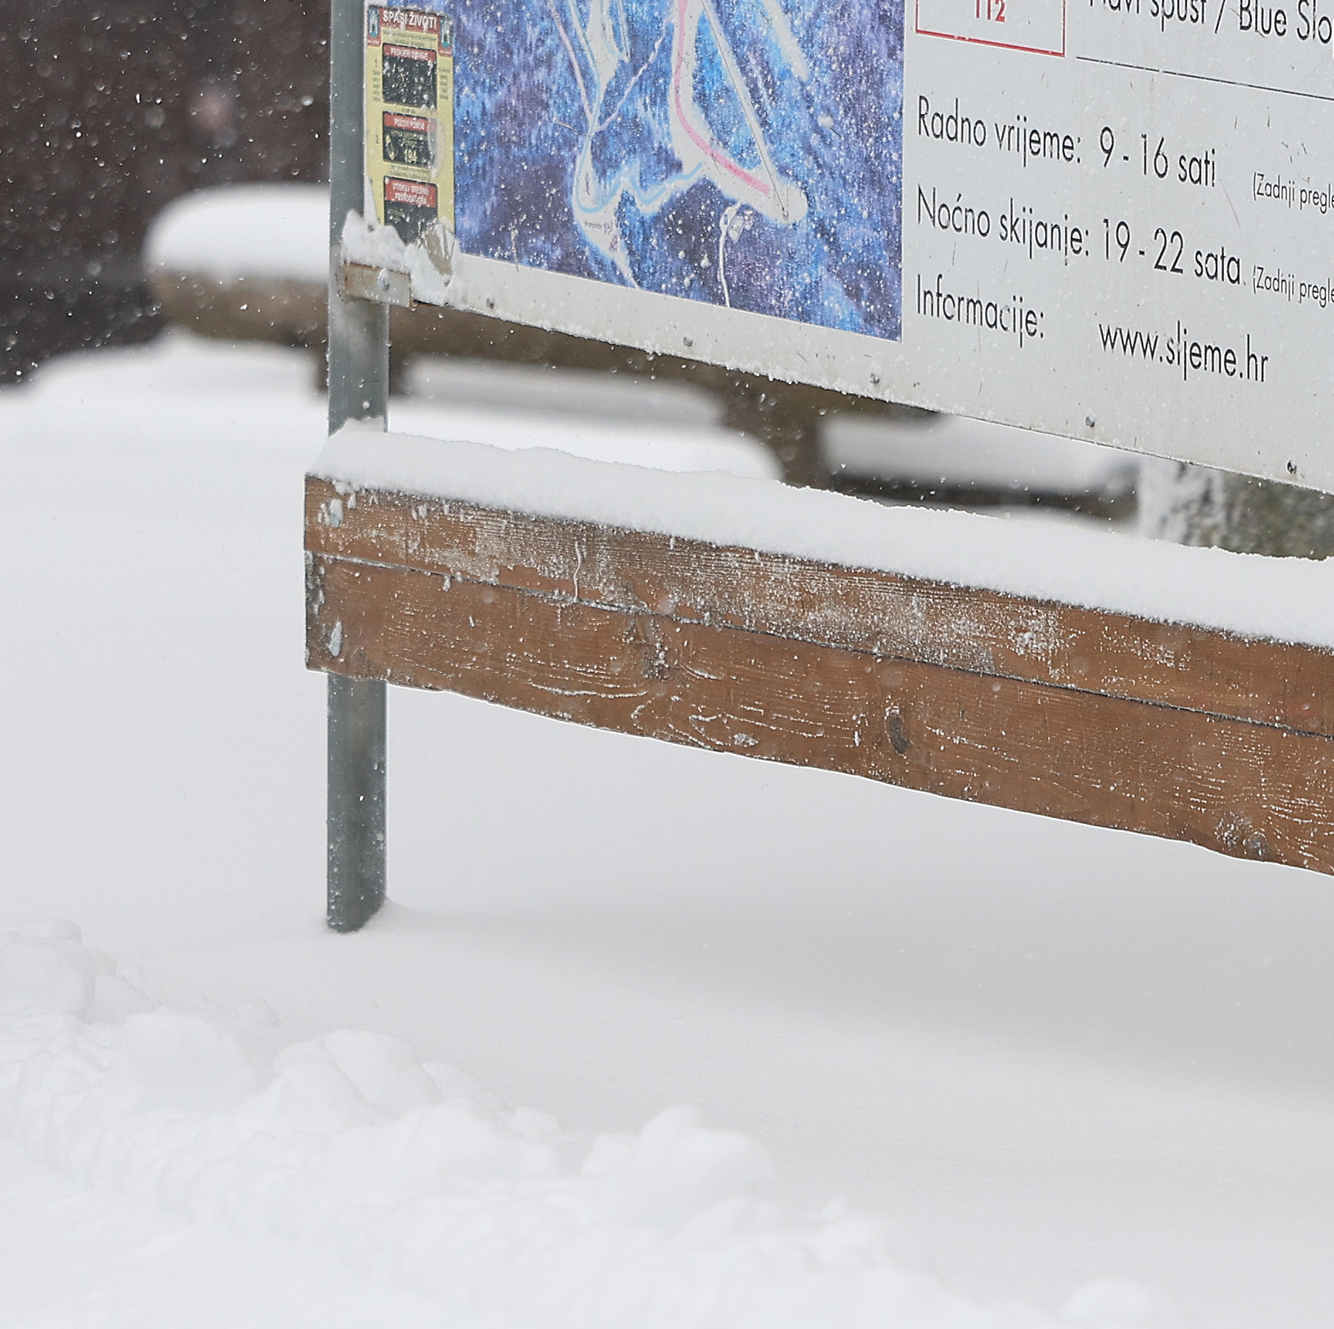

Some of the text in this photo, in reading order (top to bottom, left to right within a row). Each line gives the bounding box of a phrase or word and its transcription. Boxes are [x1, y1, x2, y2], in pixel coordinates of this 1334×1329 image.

[917, 94, 987, 148] Radno
[994, 114, 1082, 168] vrijeme:
[1099, 126, 1115, 169] 9
[1141, 133, 1169, 179] 16
[1178, 148, 1217, 188] sati
[1252, 172, 1296, 209] (Zadnji
[917, 184, 991, 238] Noćno
[999, 198, 1090, 266] skijanje:
[1103, 218, 1131, 263] 19
[1153, 227, 1184, 274] 22
[1252, 265, 1295, 302] (Zadnji
[917, 274, 1269, 382] Informacije: www.sljeme.hr
